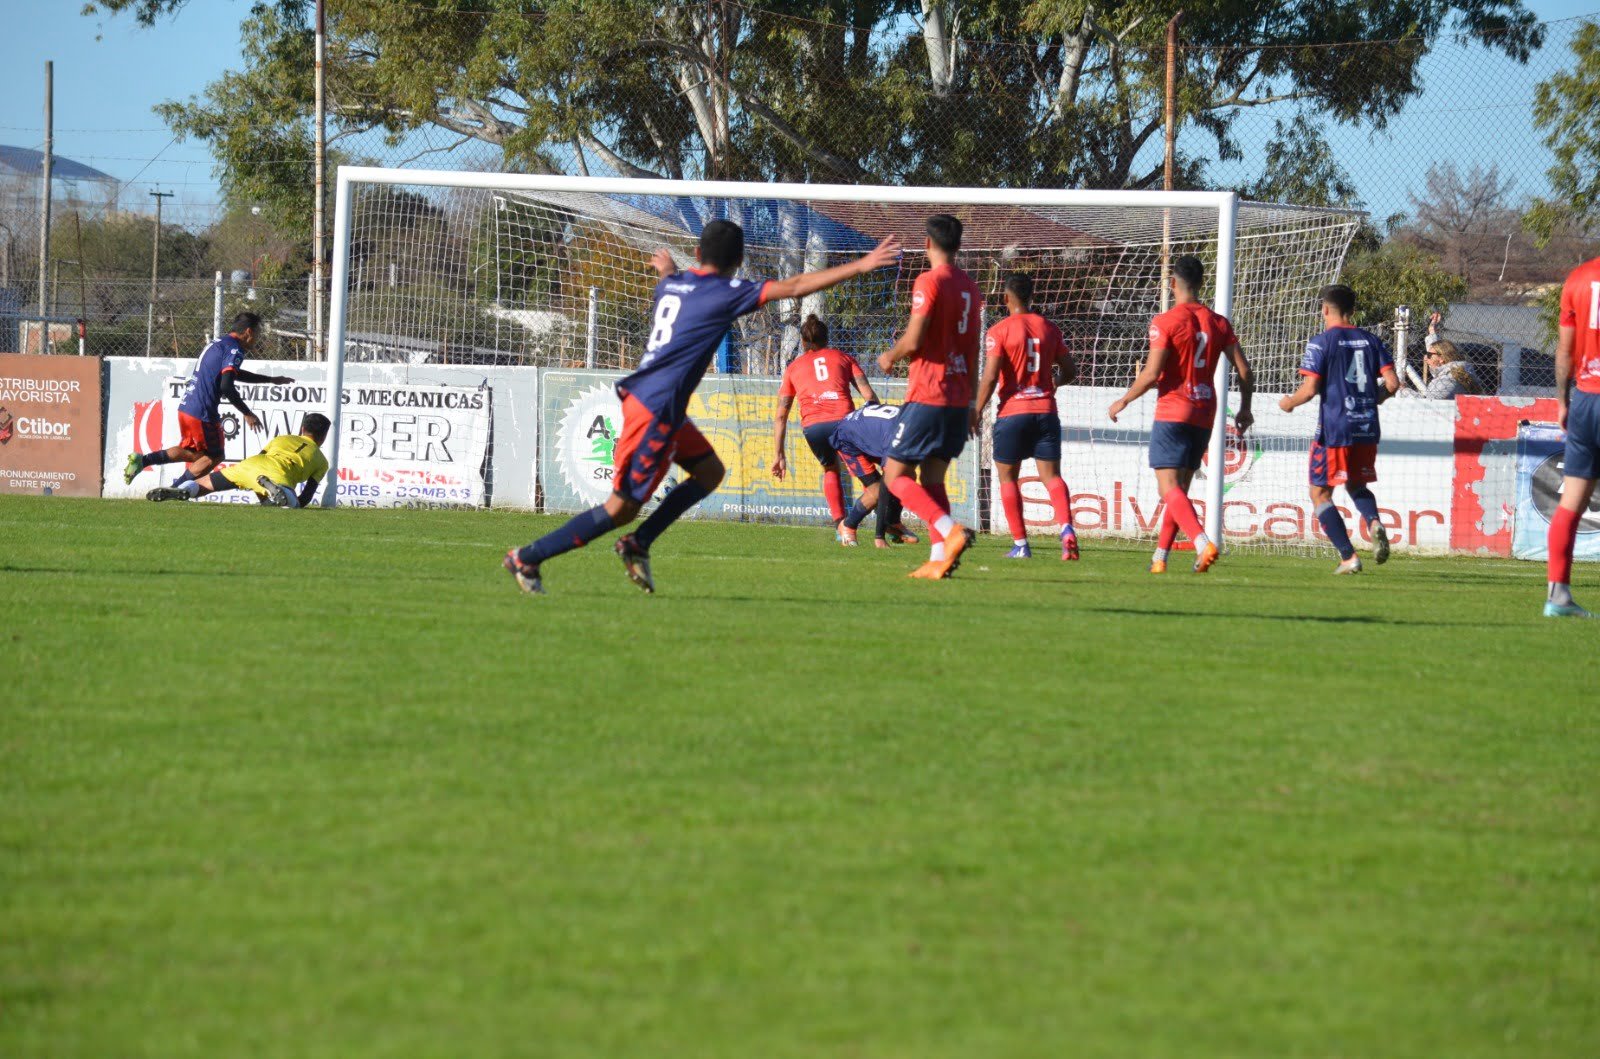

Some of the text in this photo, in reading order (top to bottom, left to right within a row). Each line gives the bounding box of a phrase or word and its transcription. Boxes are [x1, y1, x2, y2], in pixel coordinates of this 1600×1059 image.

[647, 295, 681, 352] 8
[957, 291, 971, 334] 3
[1026, 338, 1040, 372] 5
[1193, 332, 1207, 368] 2
[813, 357, 829, 382] 6
[1345, 350, 1368, 393] 4
[0, 390, 71, 404] AYORISTA
[357, 389, 484, 410] MECANICAS
[17, 417, 71, 436] Ctibor
[0, 469, 76, 481] RONUNCIAMIENTO
[10, 479, 61, 490] ENTRE RIOS
